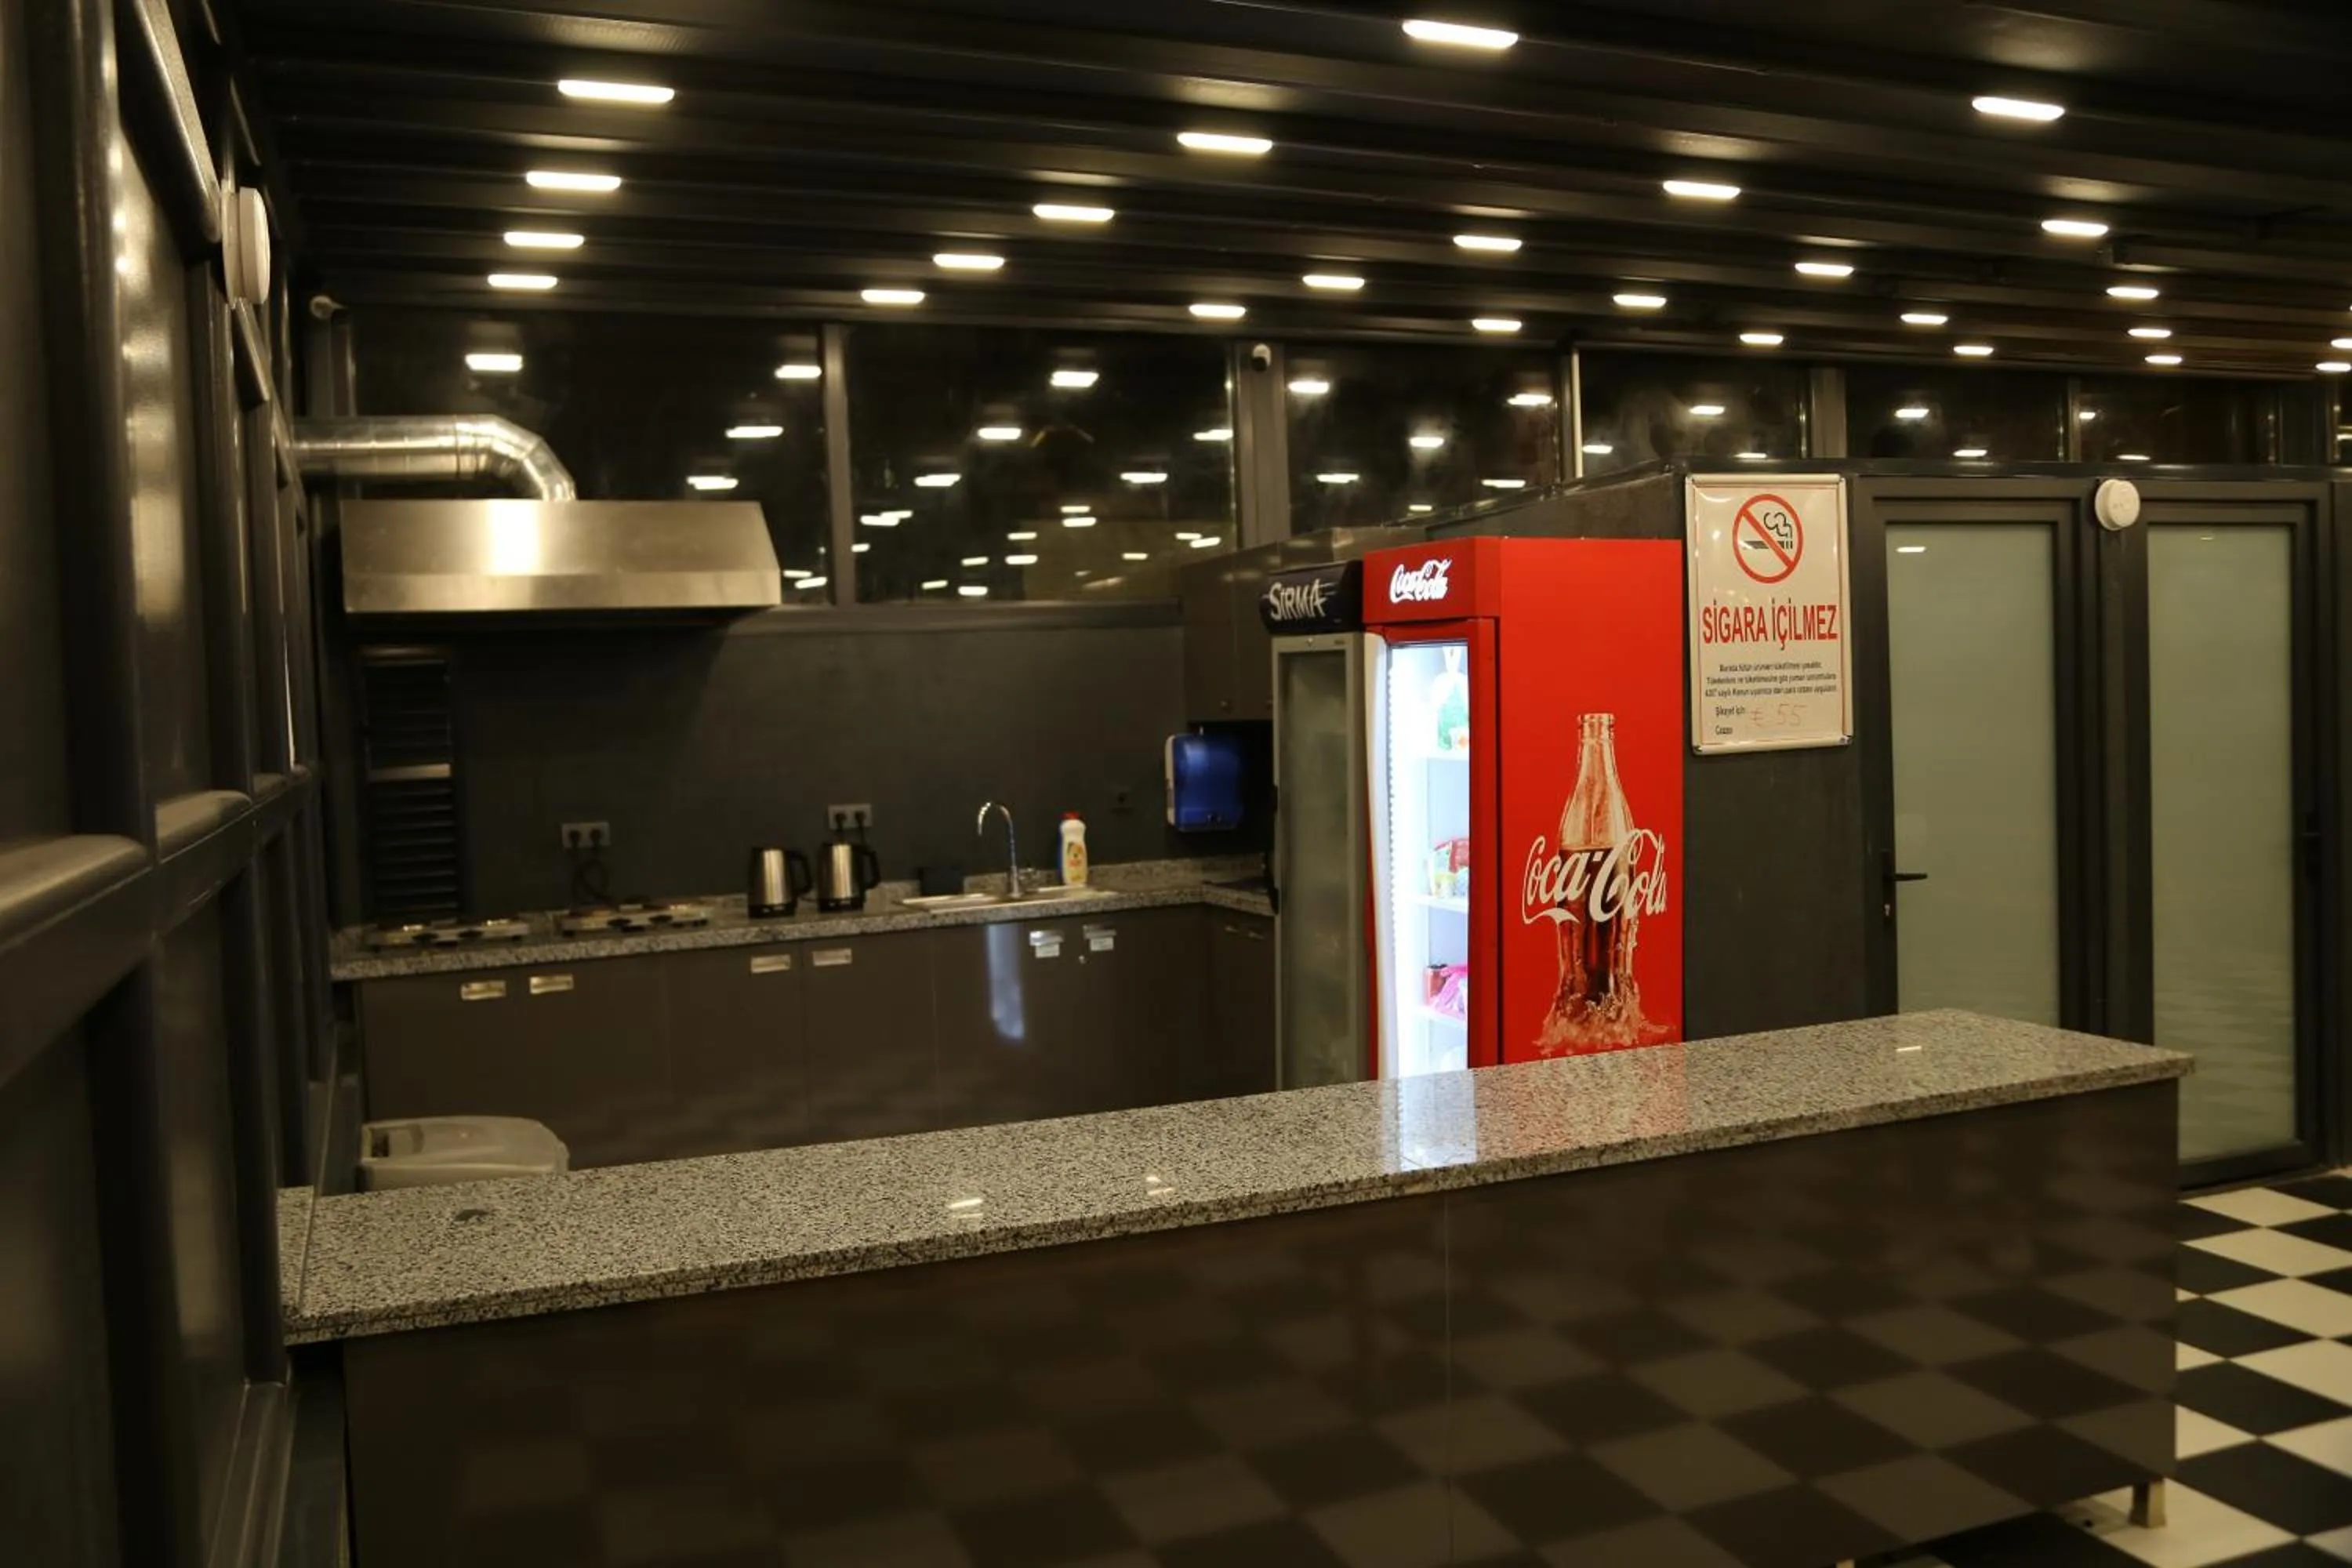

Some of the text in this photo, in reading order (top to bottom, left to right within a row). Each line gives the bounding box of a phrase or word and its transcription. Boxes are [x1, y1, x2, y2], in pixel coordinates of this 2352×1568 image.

[1702, 597, 1838, 650] SİGARA İÇİLMEZ
[1522, 828, 1667, 924] Coca-Cola
